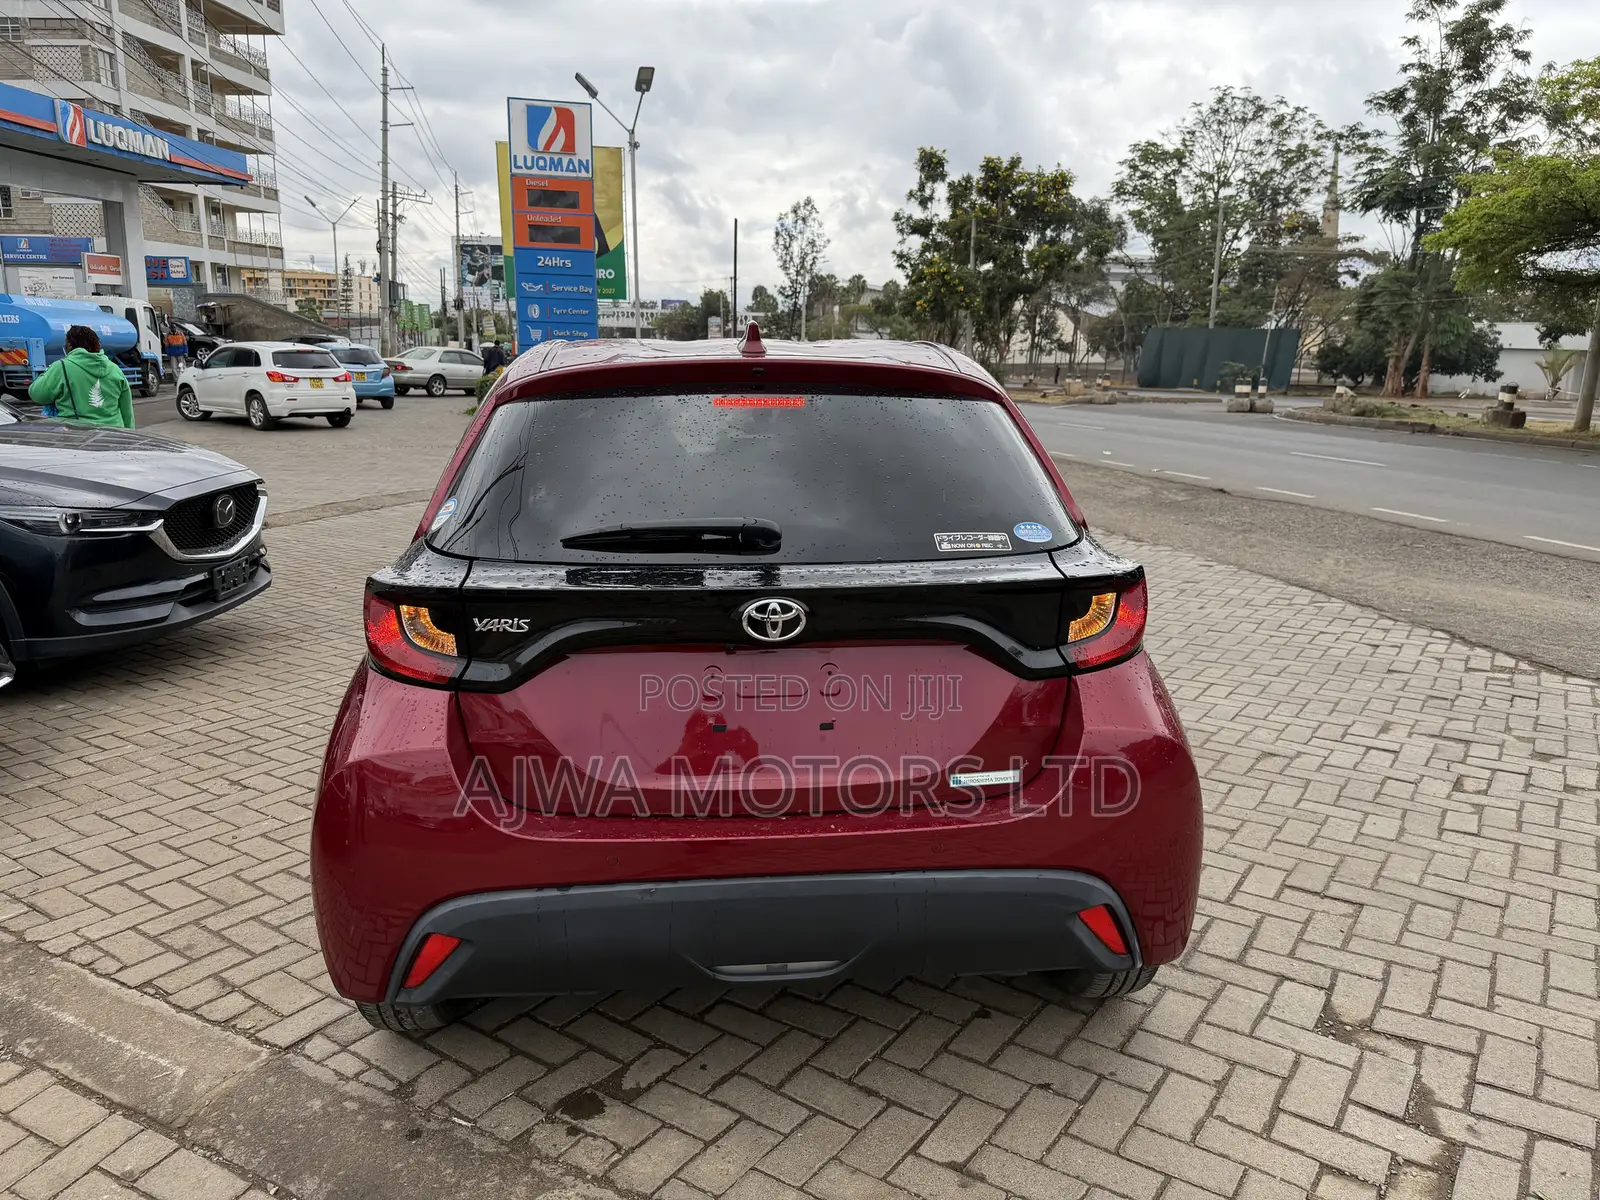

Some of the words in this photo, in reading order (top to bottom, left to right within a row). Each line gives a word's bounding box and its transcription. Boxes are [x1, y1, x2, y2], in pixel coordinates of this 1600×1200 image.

[86, 117, 170, 160] LUQMAN
[513, 154, 590, 174] LUQMAN
[525, 178, 549, 187] Diesel
[527, 214, 562, 223] Unleaded
[536, 256, 572, 268] 24Hrs
[551, 285, 577, 293] Service
[579, 286, 593, 295] Bay
[552, 307, 567, 315] Tyre
[572, 331, 588, 339] Shop
